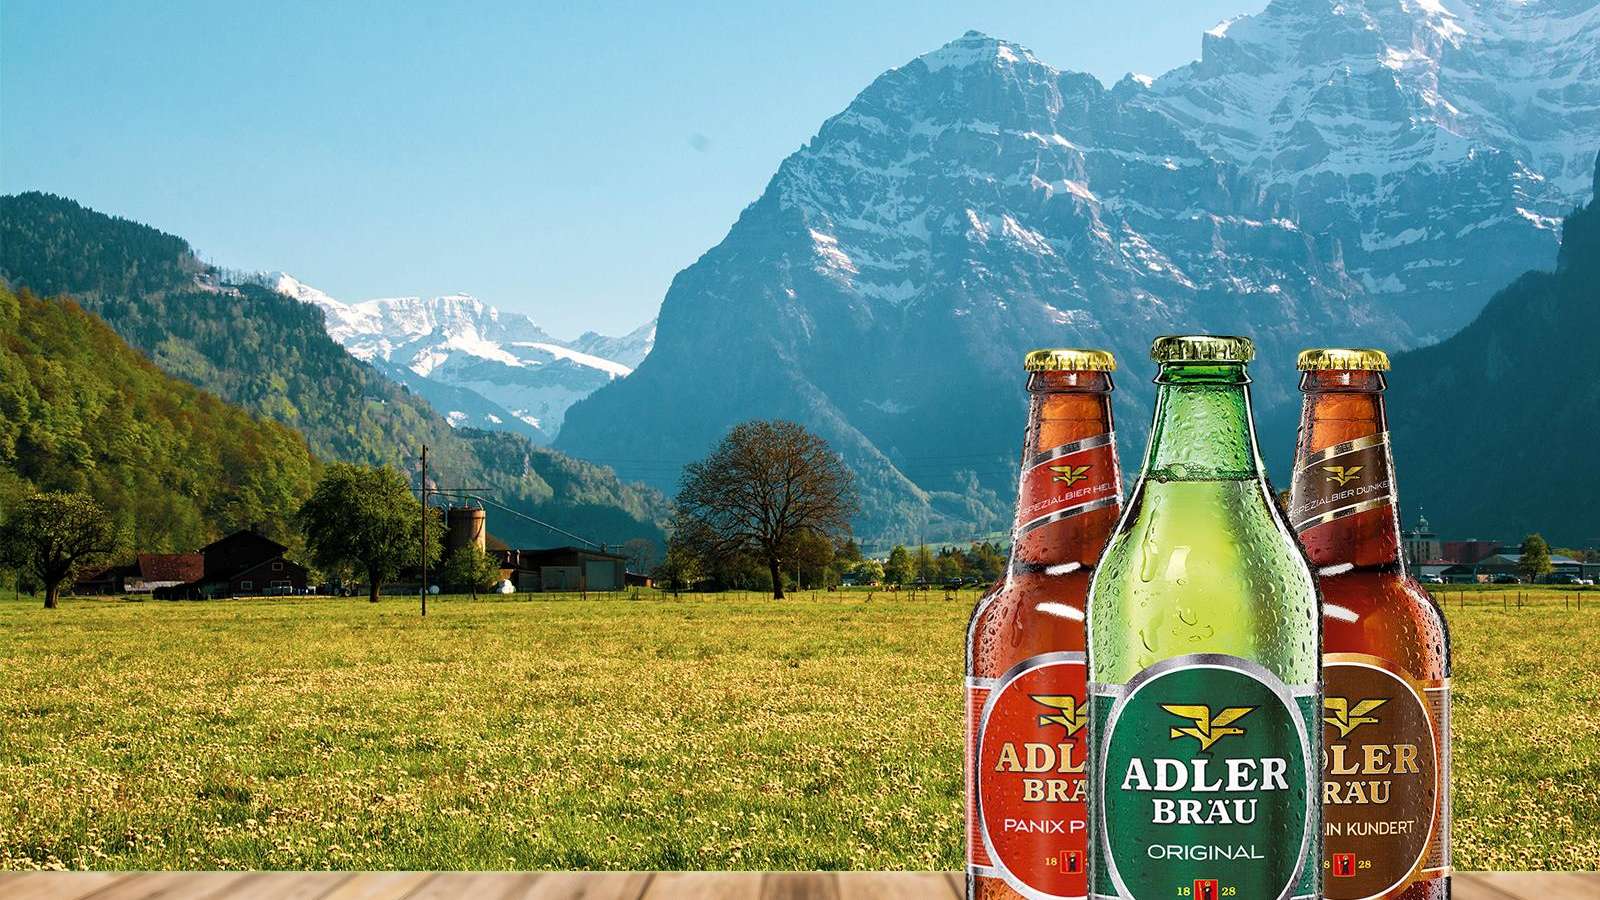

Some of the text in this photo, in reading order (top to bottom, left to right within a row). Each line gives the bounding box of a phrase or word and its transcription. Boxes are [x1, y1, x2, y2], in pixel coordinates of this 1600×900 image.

[1293, 480, 1390, 516] SPEZIALBIER DUNKE
[995, 742, 1086, 773] ADL
[1322, 743, 1420, 775] LER
[1120, 757, 1290, 792] ADLER
[1022, 778, 1088, 802] BRÄ
[1323, 780, 1392, 805] RÄU
[1151, 798, 1258, 825] BRÄU
[1004, 818, 1088, 834] PANIX P
[1323, 820, 1415, 836] IN KUNDERT
[1044, 857, 1058, 866] 18
[1147, 844, 1265, 861] ORIGINAL
[1358, 860, 1372, 869] 28
[1176, 886, 1236, 897] 18 28
